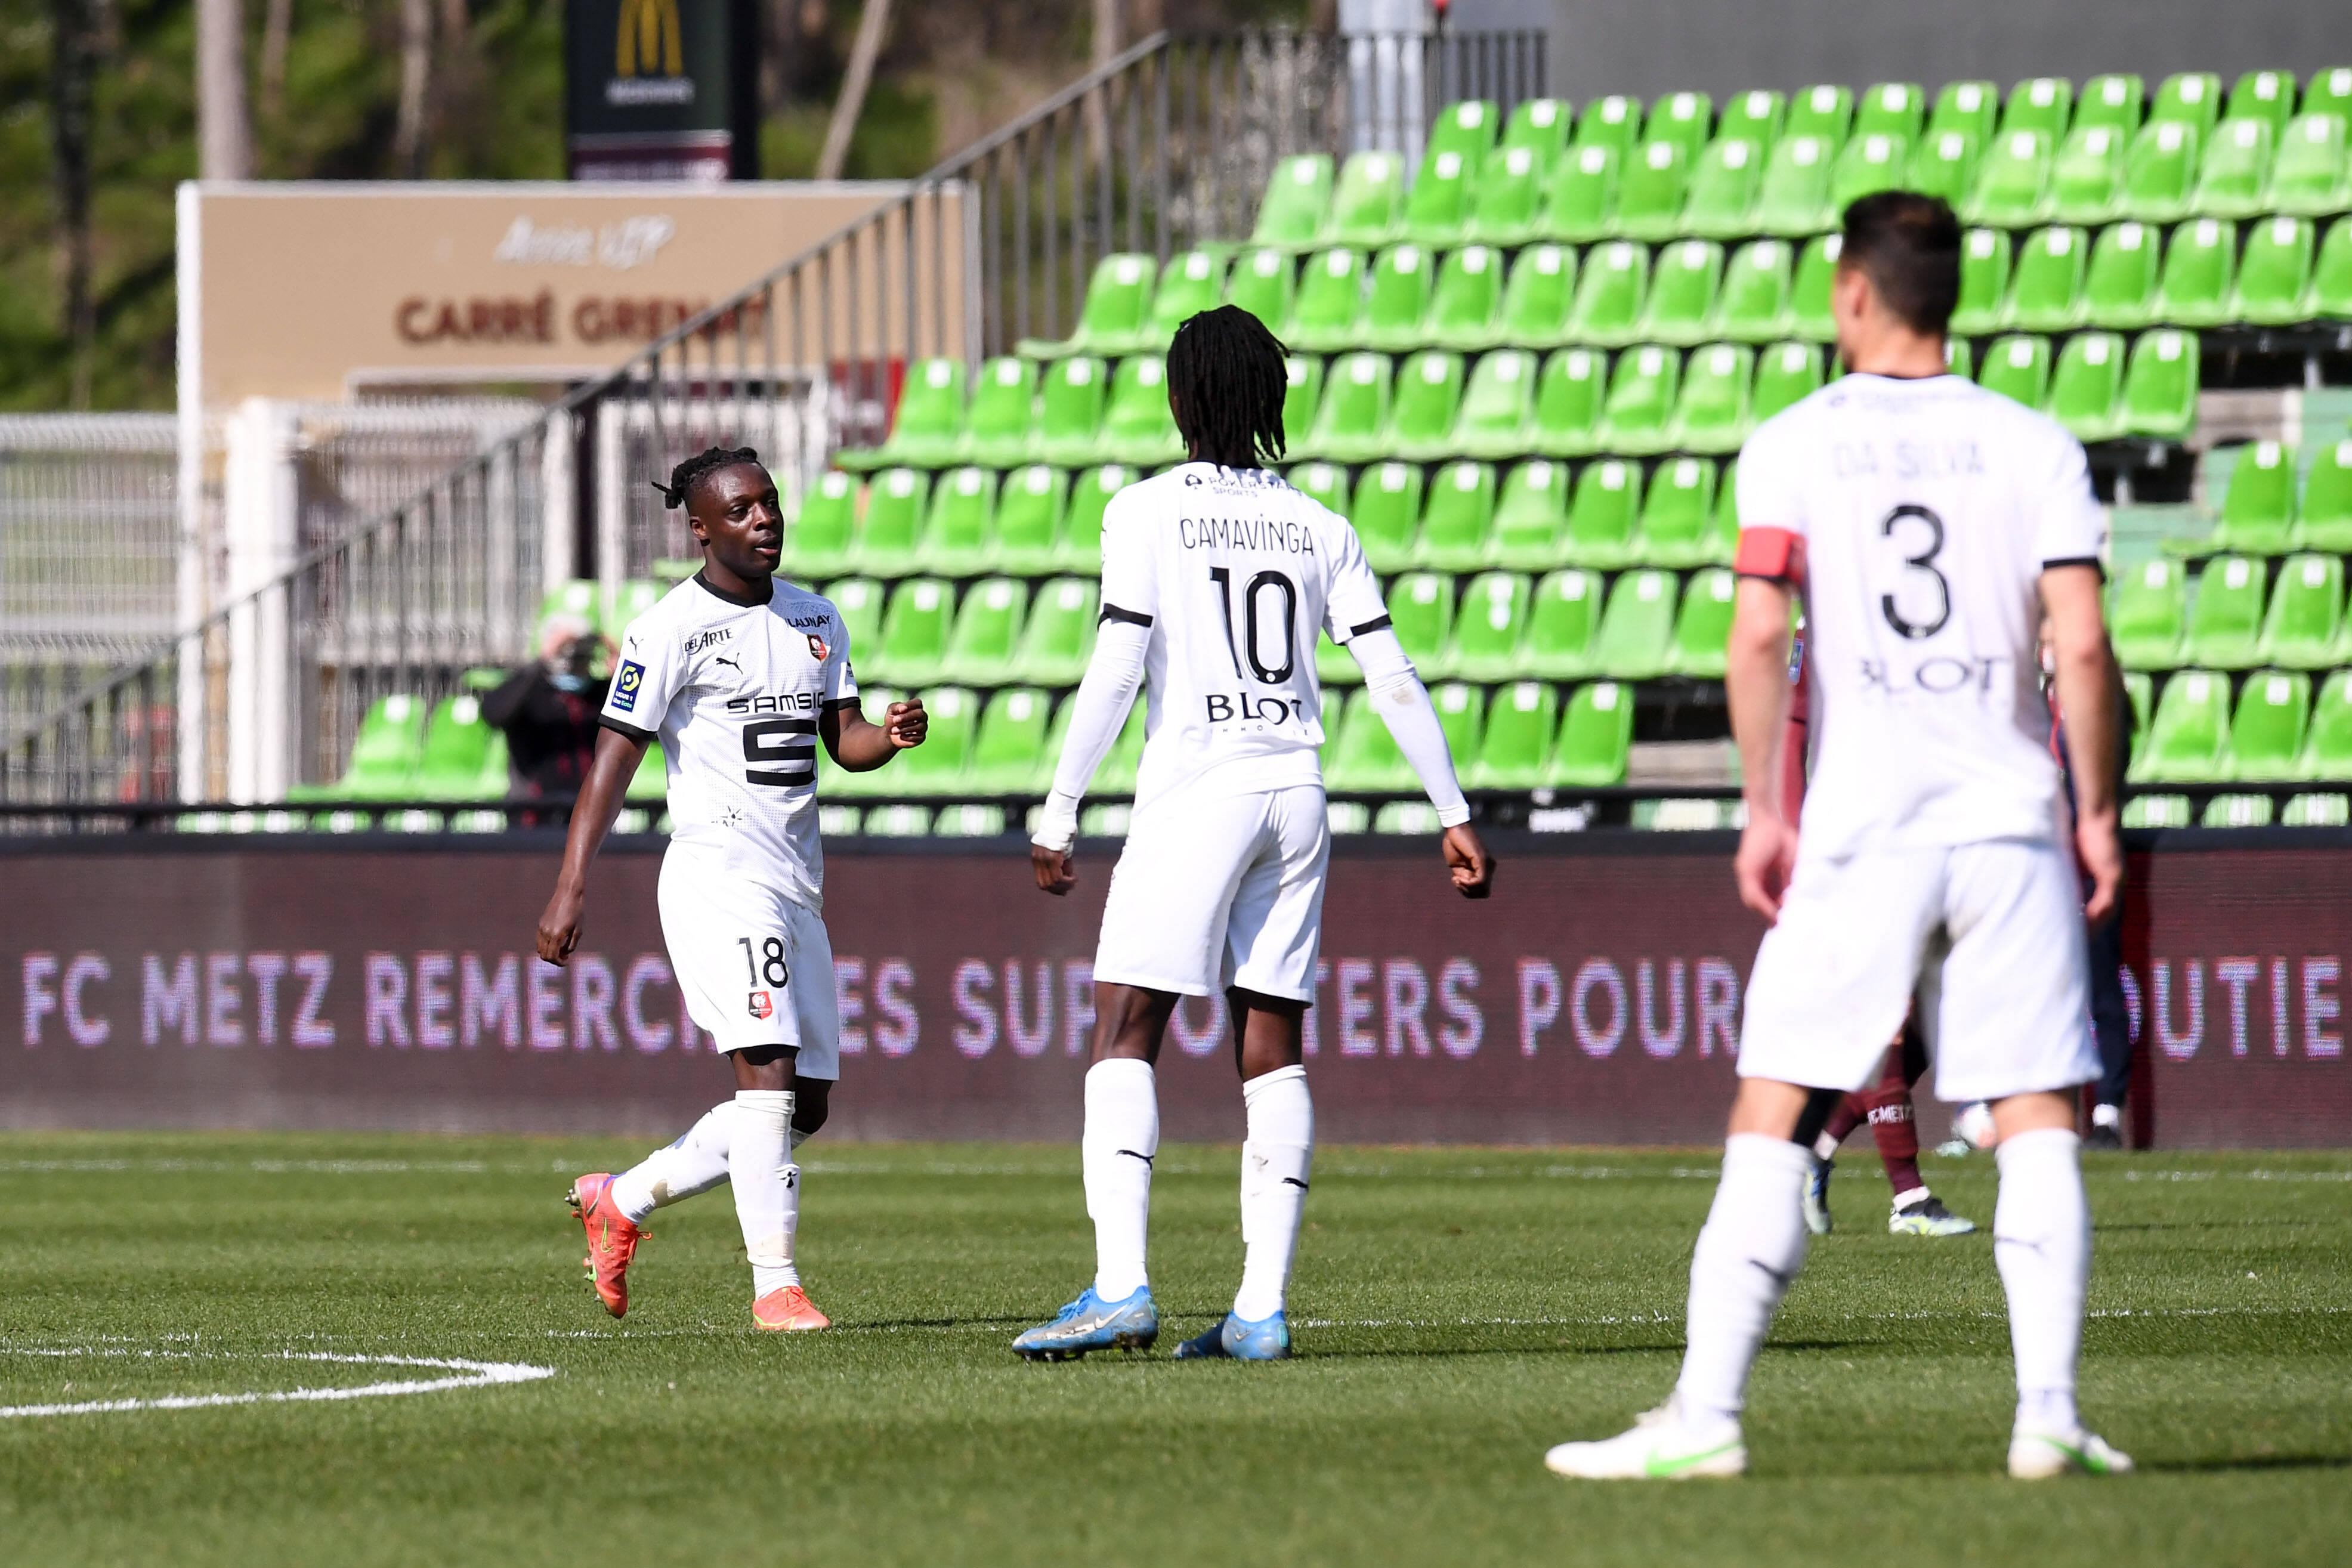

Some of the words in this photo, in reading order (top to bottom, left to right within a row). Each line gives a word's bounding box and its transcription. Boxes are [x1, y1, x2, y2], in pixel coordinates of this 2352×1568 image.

[395, 286, 555, 346] CARRÉ
[1213, 486, 1258, 498] SPORTS
[1180, 514, 1314, 556] CAMAVINGA
[1881, 504, 1951, 639] 3
[1209, 565, 1297, 685] 10
[1205, 691, 1305, 726] BLOT
[736, 936, 789, 988] 18
[21, 950, 112, 1049] FC
[141, 949, 339, 1049] METZ
[363, 950, 719, 1054] REMERCI
[834, 955, 920, 1059] ES
[1515, 954, 1741, 1059] POUR
